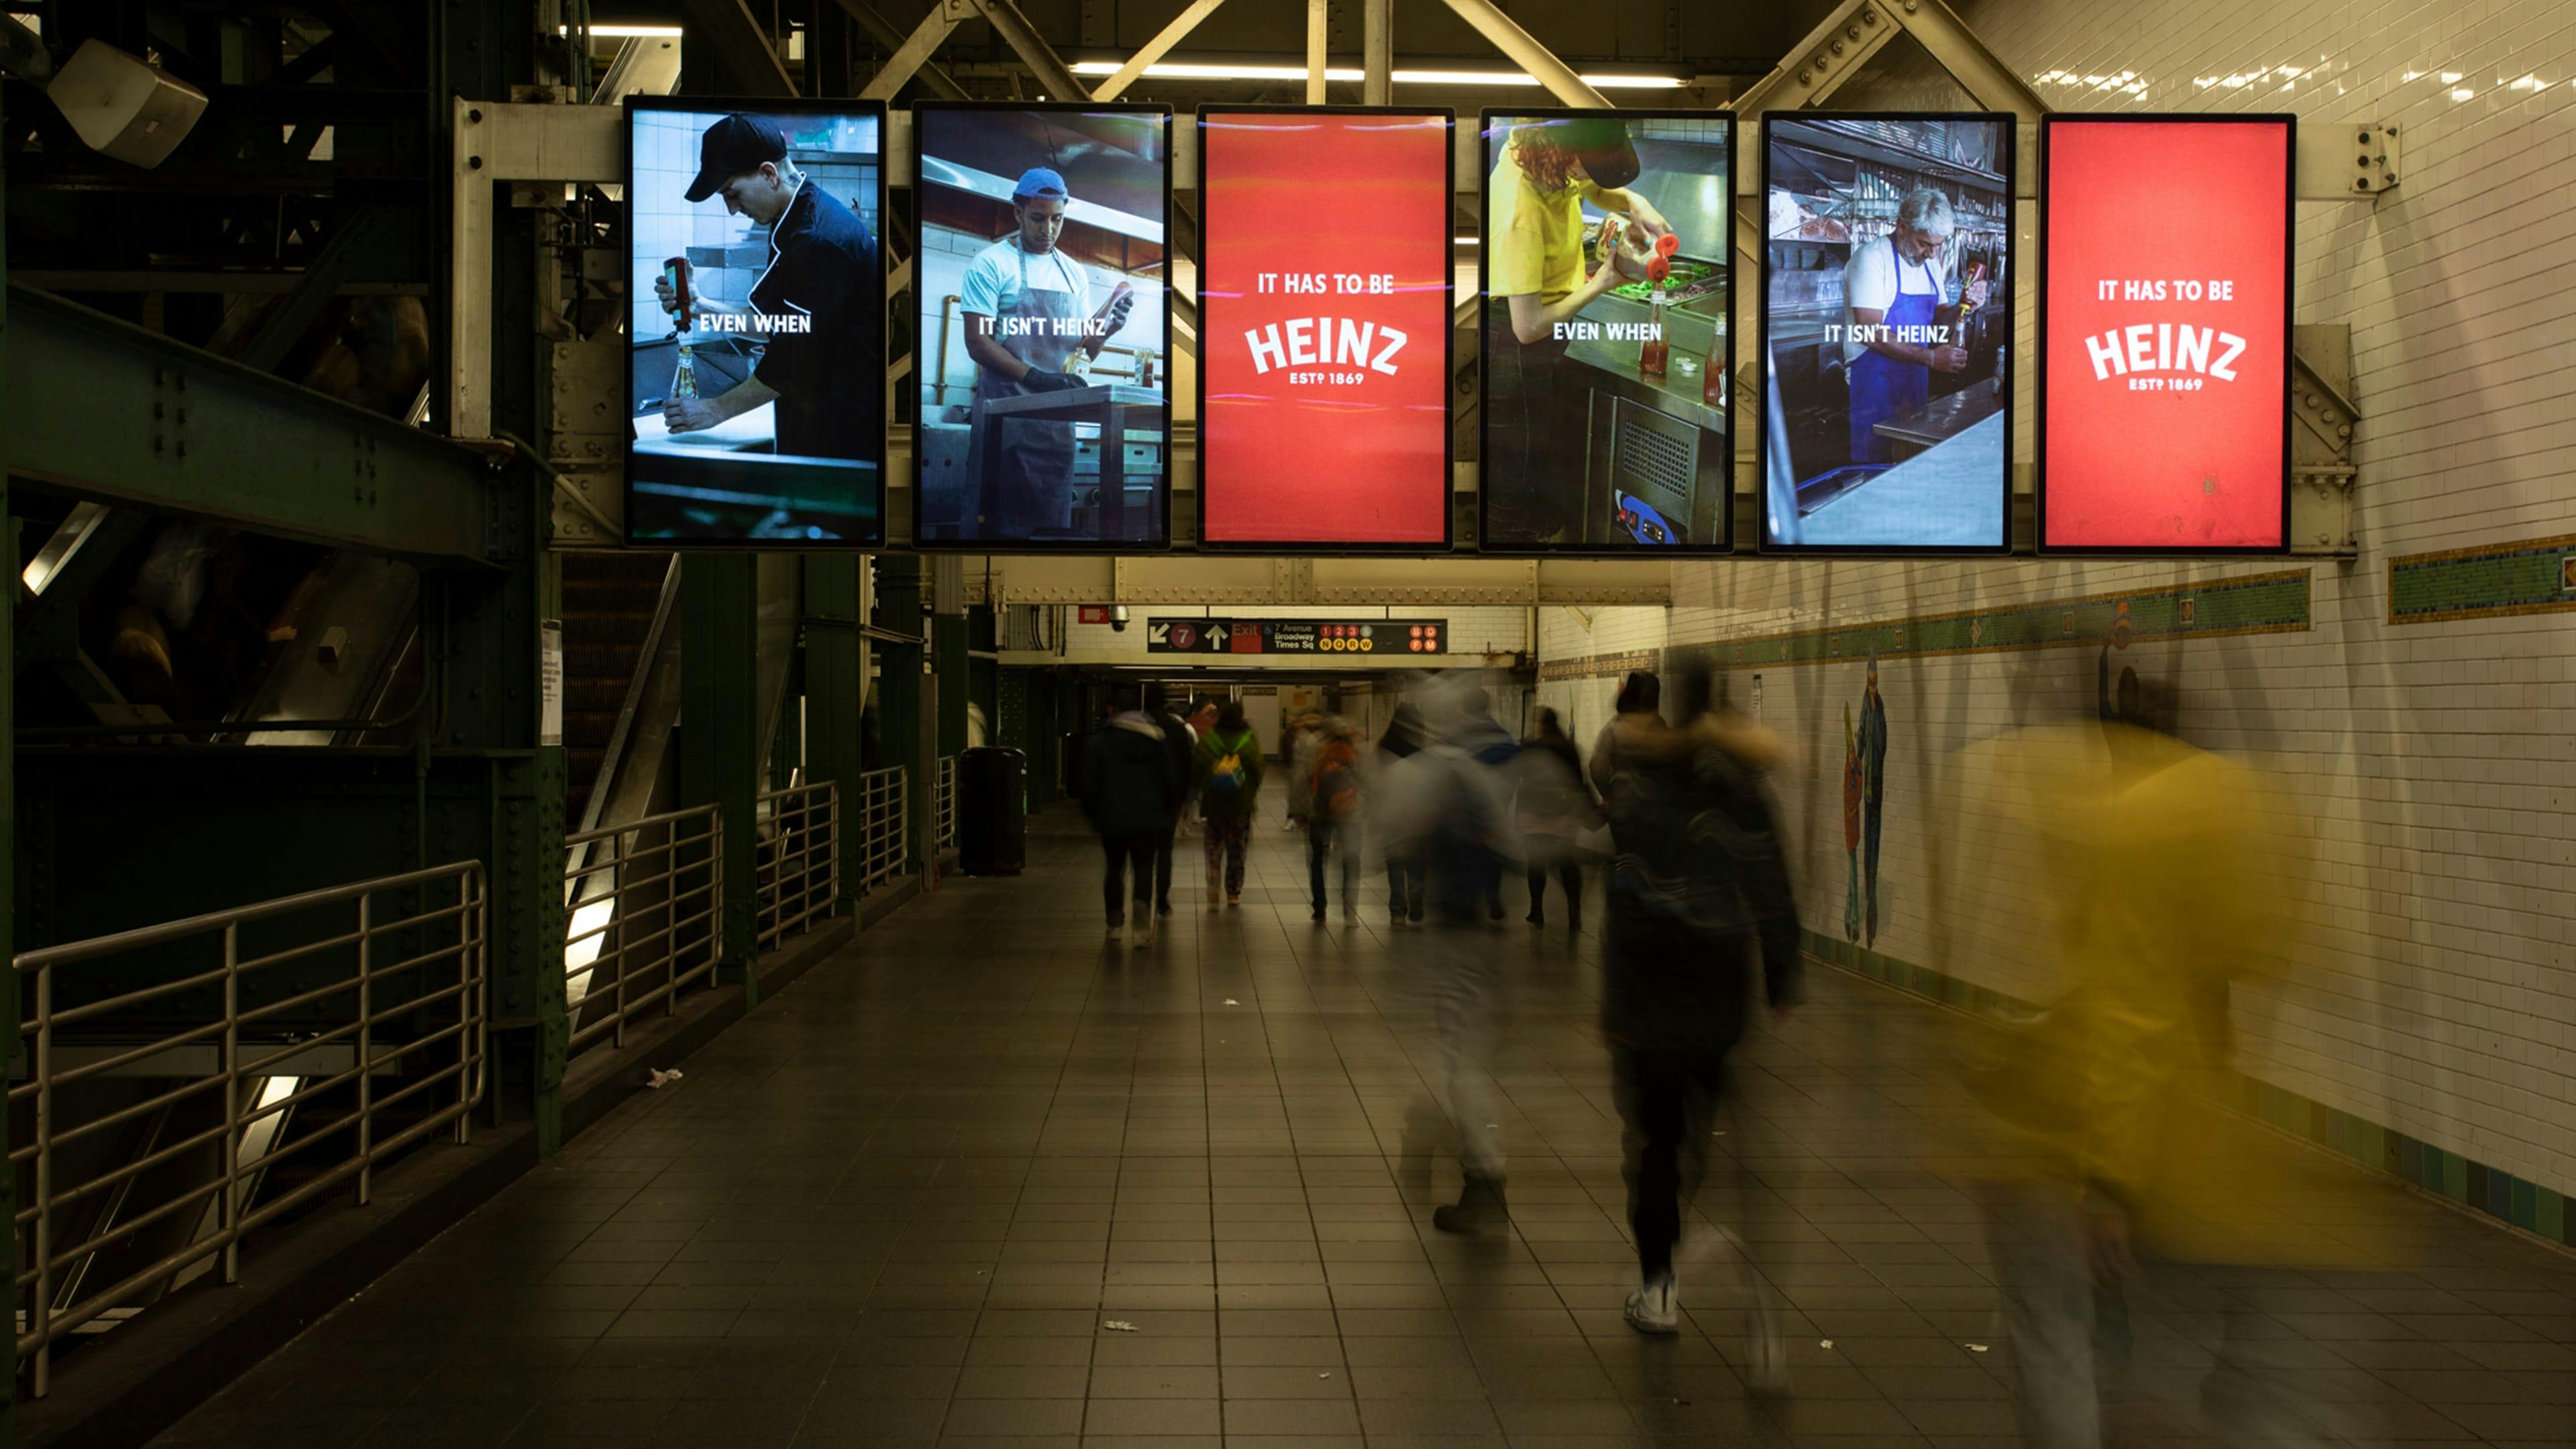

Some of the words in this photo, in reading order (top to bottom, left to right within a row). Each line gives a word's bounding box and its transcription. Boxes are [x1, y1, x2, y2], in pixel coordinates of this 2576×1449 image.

[1258, 273, 1278, 294] IT
[1285, 273, 1327, 294] HAS
[1333, 273, 1363, 294] TO
[1368, 274, 1394, 294] BE
[2098, 280, 2118, 301] IT
[2124, 280, 2167, 301] HAS
[2173, 280, 2203, 301] TO
[2208, 280, 2233, 301] BE
[700, 314, 747, 331] EVEN
[754, 315, 811, 333] WHEN
[979, 317, 997, 335] IT
[1002, 317, 1046, 335] ISN'T
[1053, 318, 1106, 336] HEINZ
[1554, 322, 1600, 340] EVEN
[1606, 323, 1662, 341] WHEN
[1824, 325, 1842, 342] IT
[1847, 323, 1891, 343] ISN'T
[1896, 325, 1949, 343] HEINZ
[1244, 317, 1407, 376] HEINZ
[2085, 323, 2247, 382] HEINZ
[1329, 372, 1364, 384] 1869
[2168, 378, 2203, 390] 1869
[1233, 623, 1258, 636] Exit
[1275, 623, 1281, 632] 7
[1282, 624, 1312, 632] Avenue
[1178, 629, 1190, 644] 7
[1275, 632, 1315, 642] Broadway
[1275, 640, 1299, 649] Times
[1302, 640, 1314, 649] Sq
[1322, 640, 1330, 648] N
[1350, 640, 1356, 648] R
[1362, 641, 1370, 649] W
